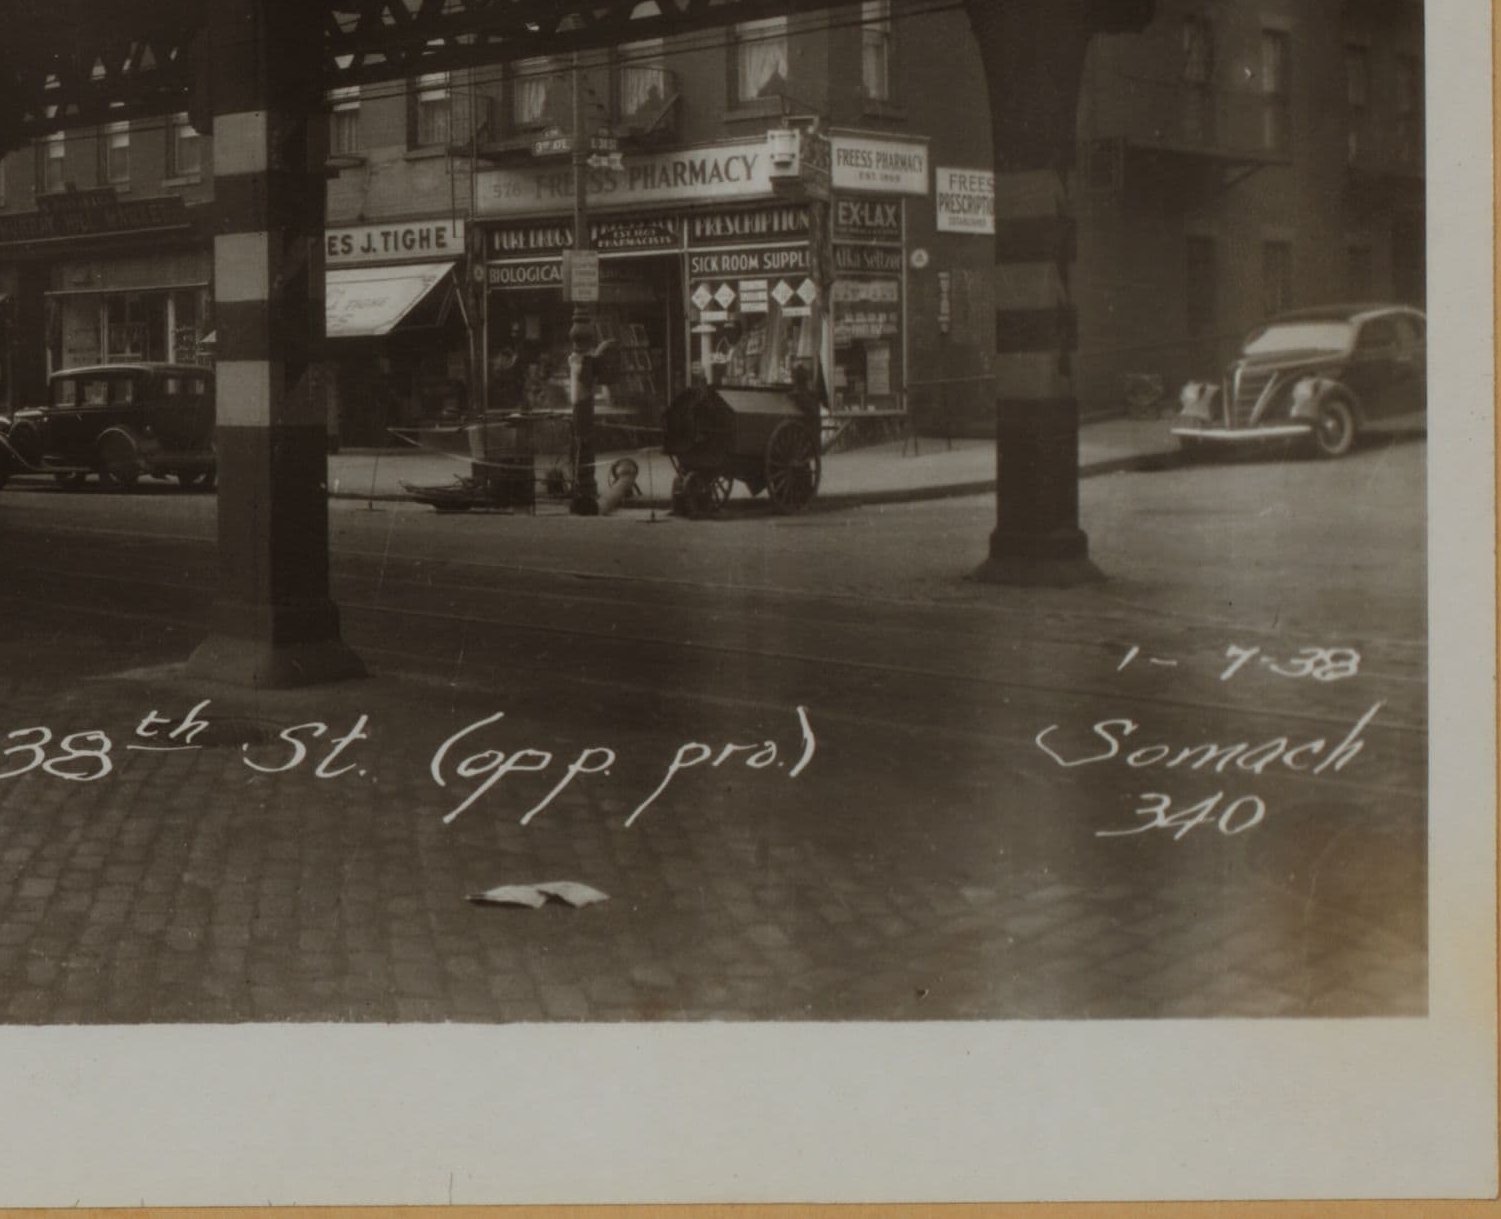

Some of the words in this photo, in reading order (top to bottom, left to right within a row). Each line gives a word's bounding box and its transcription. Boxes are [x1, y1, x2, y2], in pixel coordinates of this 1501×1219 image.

[836, 148, 873, 168] FREESS
[875, 151, 924, 174] PHARMACY
[534, 168, 616, 199] FRESS
[630, 153, 759, 191] PHARMACY
[694, 209, 810, 237] PRESCRIPTION
[327, 234, 354, 256] ES
[360, 232, 377, 254] J.
[380, 226, 447, 252] TIGHE
[691, 255, 719, 273] SICK
[722, 253, 759, 271] ROOM
